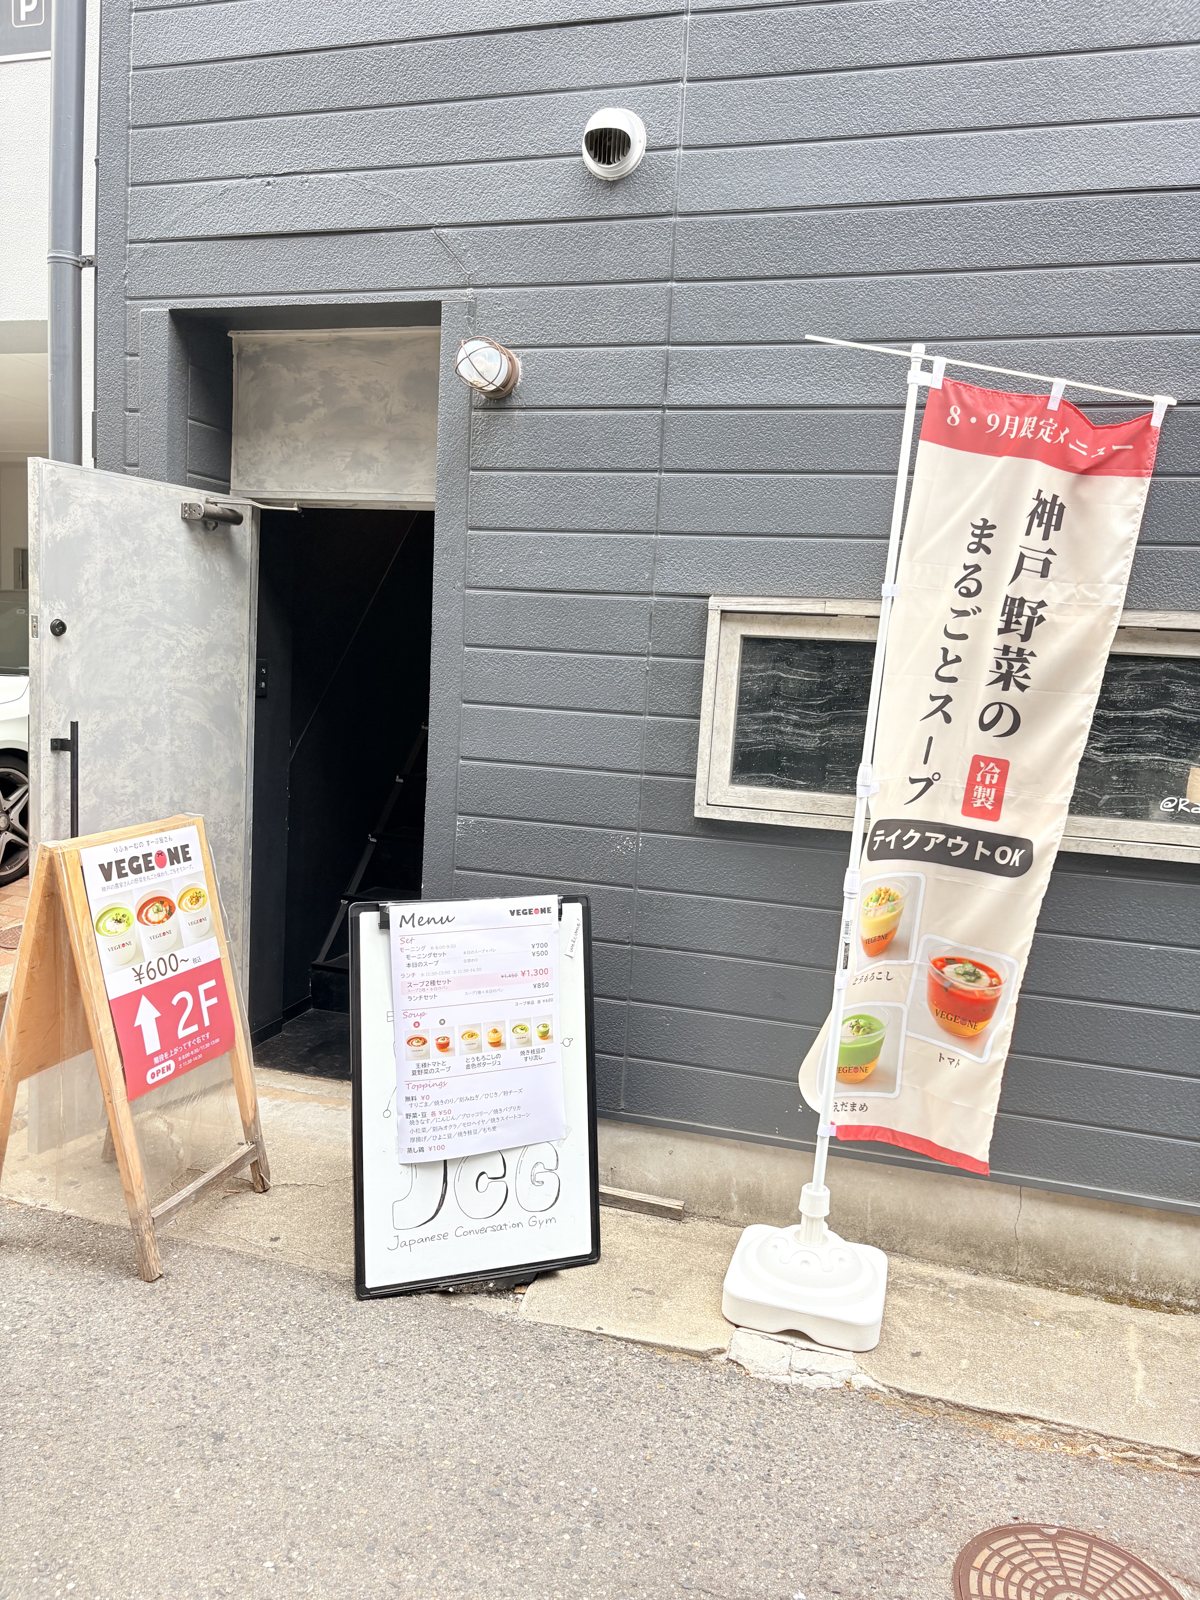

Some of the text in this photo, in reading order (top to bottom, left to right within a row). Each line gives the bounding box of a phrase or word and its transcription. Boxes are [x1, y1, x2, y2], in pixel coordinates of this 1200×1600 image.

[20, 0, 38, 21] P
[946, 405, 1134, 458] 8・9月限定メニュー
[978, 488, 1067, 738] 神戸野菜の
[903, 517, 997, 806] まるごとスープ
[971, 760, 1001, 811] 冷製
[872, 828, 1026, 867] テイクアウトOK
[98, 843, 192, 882] VEGEONE
[509, 907, 552, 917] VEGEONE
[399, 913, 455, 928] Menu
[400, 937, 415, 945] Set
[406, 951, 447, 960] モーニングセット
[406, 960, 439, 969] 本日のスープ
[407, 979, 451, 988] スープ2種セット
[407, 994, 438, 1002] ランチセット
[171, 978, 218, 1040] 2F
[402, 1010, 426, 1019] Soup
[935, 1009, 978, 1030] VEGEONE
[465, 1053, 502, 1063] とうもろこしの
[939, 1052, 960, 1068] トマト
[150, 1063, 172, 1080] OPEN
[836, 1066, 869, 1074] EGEONE
[406, 1080, 449, 1091] Toppings
[833, 1101, 869, 1113] えだまめ
[428, 1144, 446, 1152] ¥100
[387, 1215, 557, 1252] Japanese Conversation Gym
